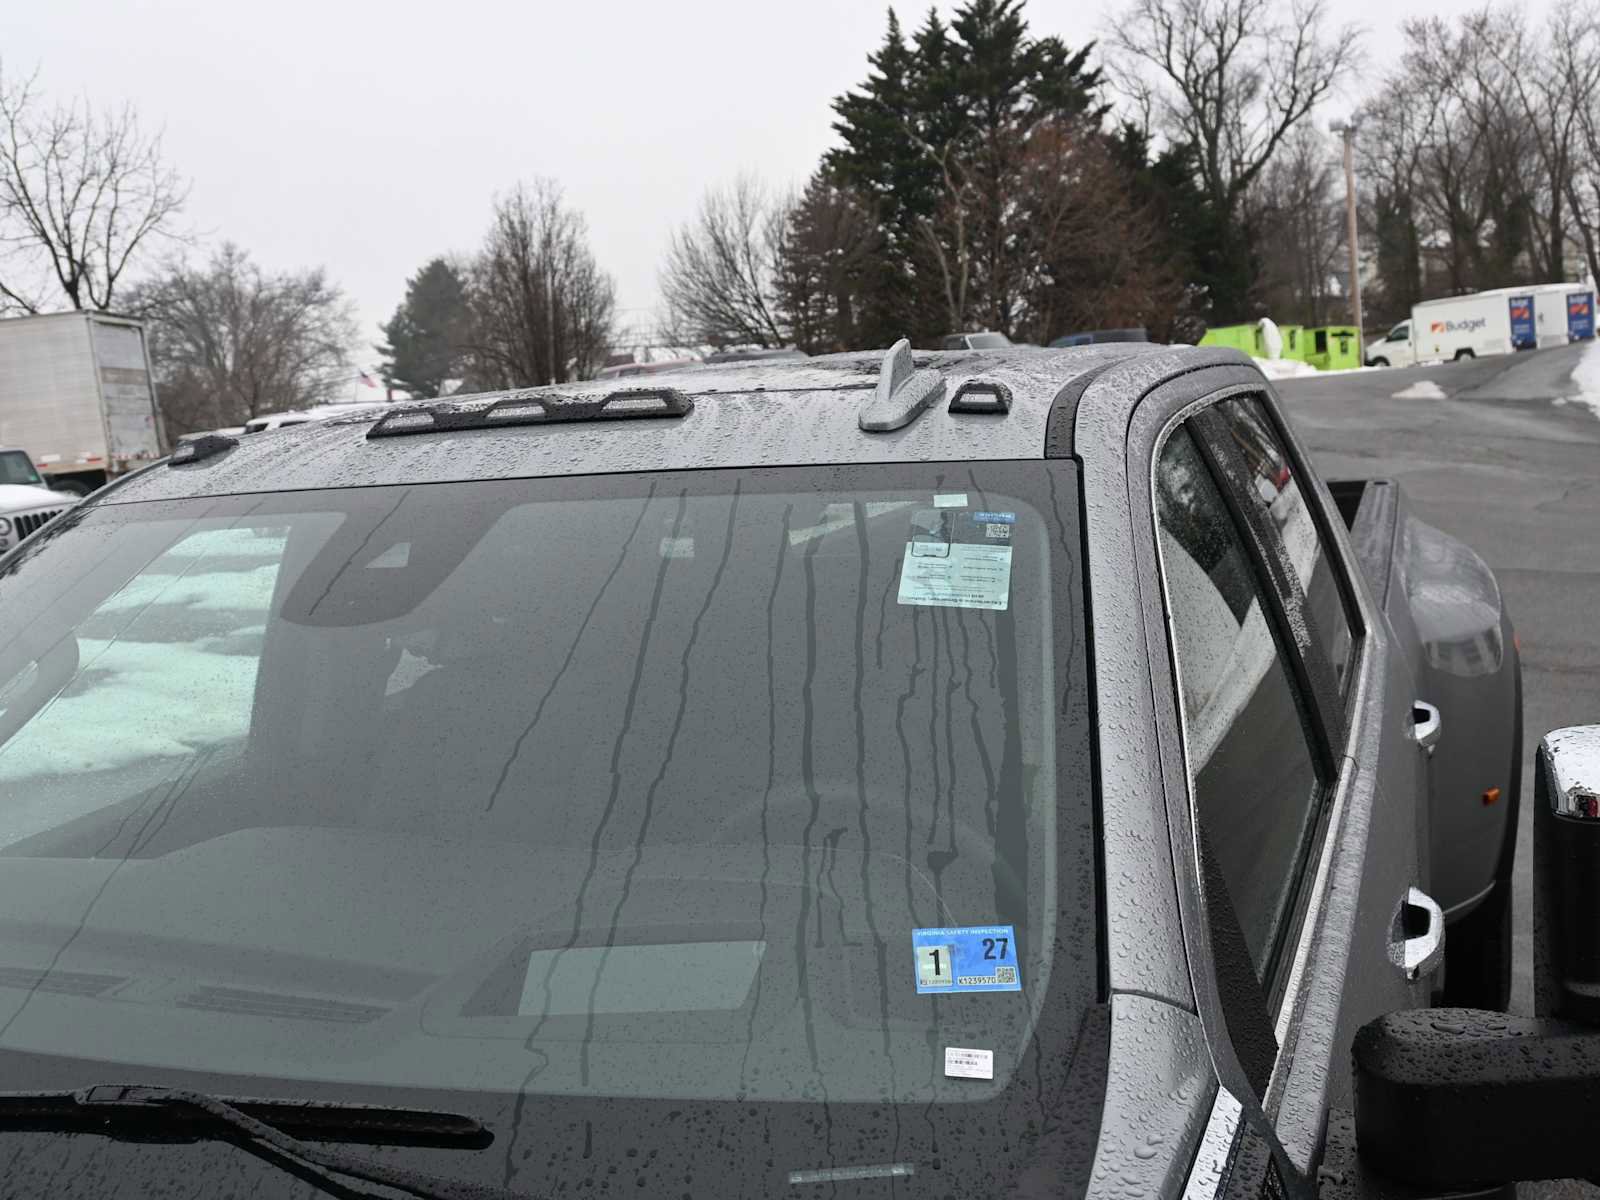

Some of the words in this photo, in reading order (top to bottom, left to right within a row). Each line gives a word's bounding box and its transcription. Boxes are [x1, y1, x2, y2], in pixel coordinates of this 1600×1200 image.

[1446, 317, 1486, 332] Budget
[982, 938, 1008, 960] 27
[928, 949, 941, 976] 1
